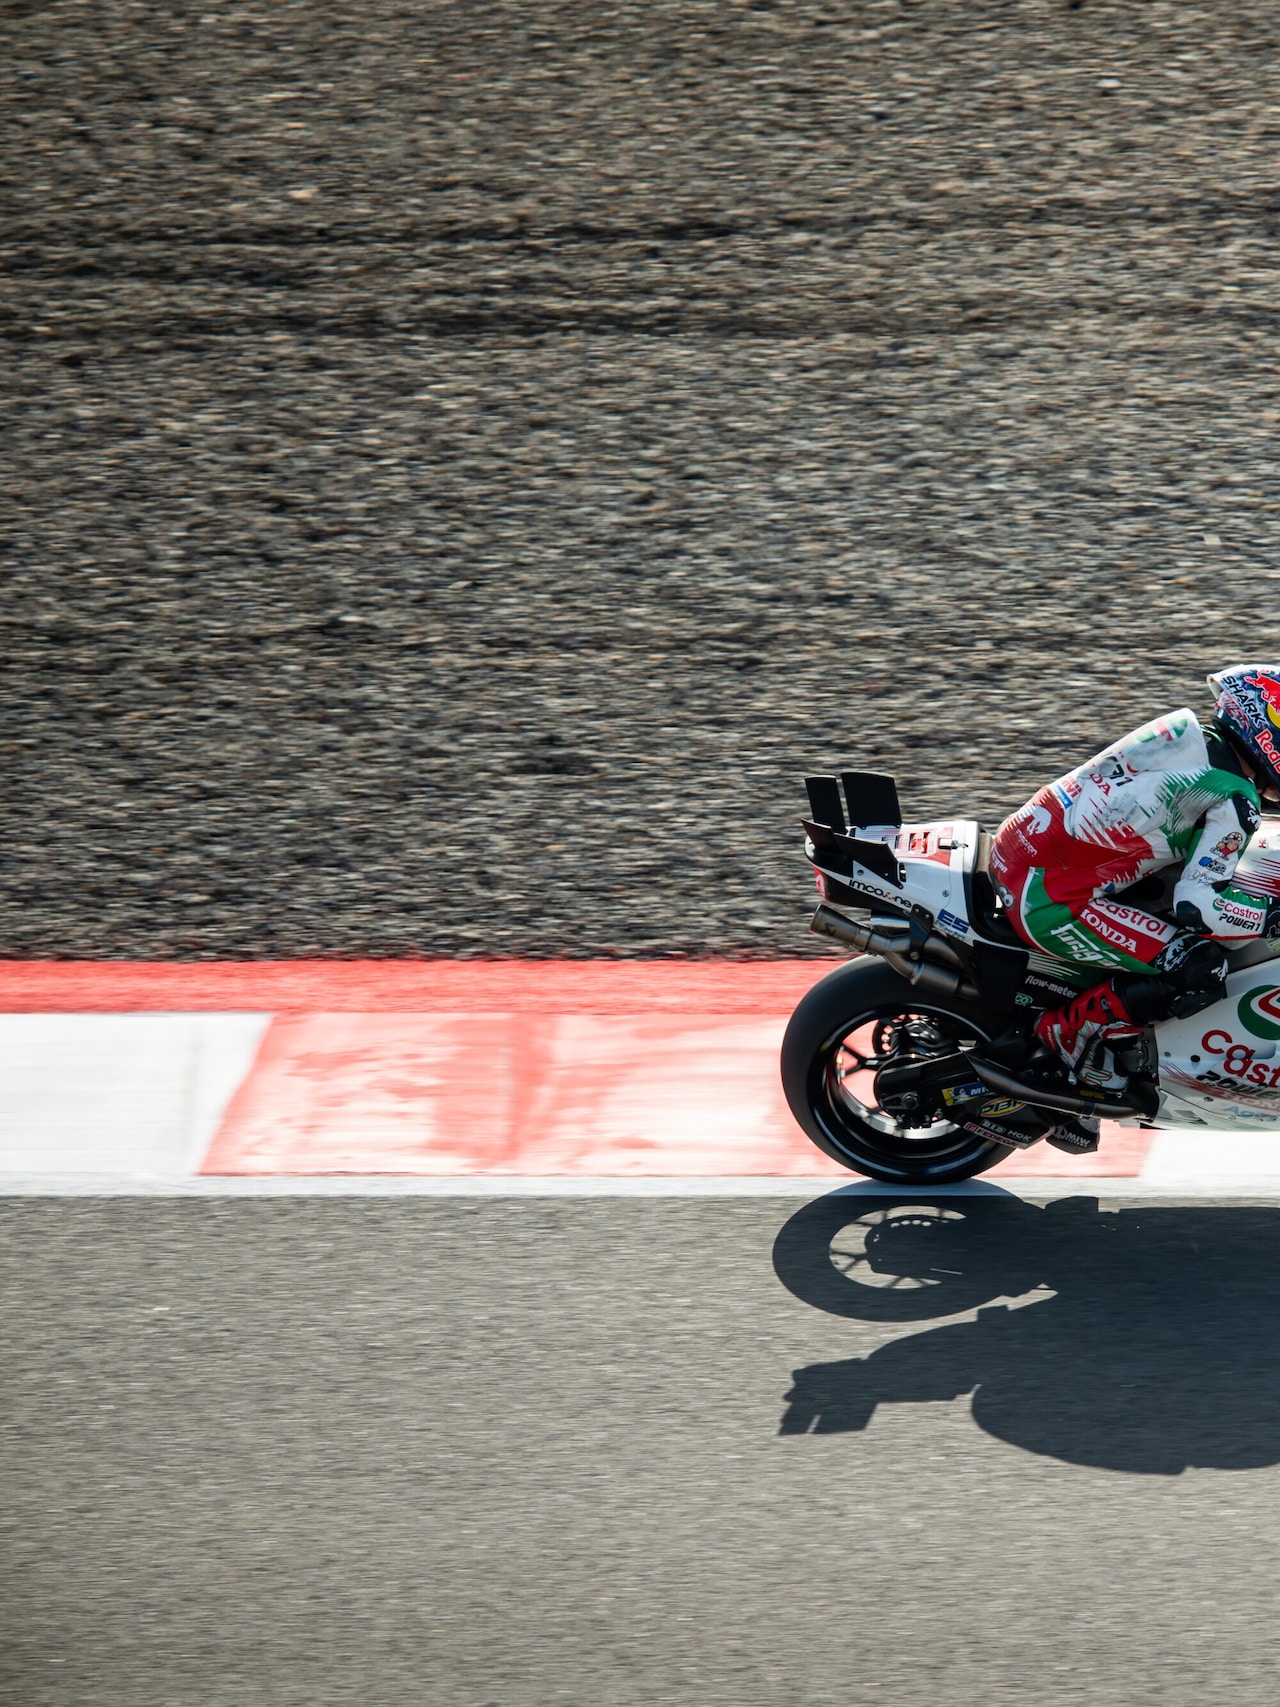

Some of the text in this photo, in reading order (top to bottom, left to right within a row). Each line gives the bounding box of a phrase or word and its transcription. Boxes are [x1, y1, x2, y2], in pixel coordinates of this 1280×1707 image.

[1222, 675, 1269, 729] SHARK
[1093, 897, 1169, 937] Castrol
[1223, 903, 1264, 922] Castrol
[1024, 974, 1079, 1000] flow-meter
